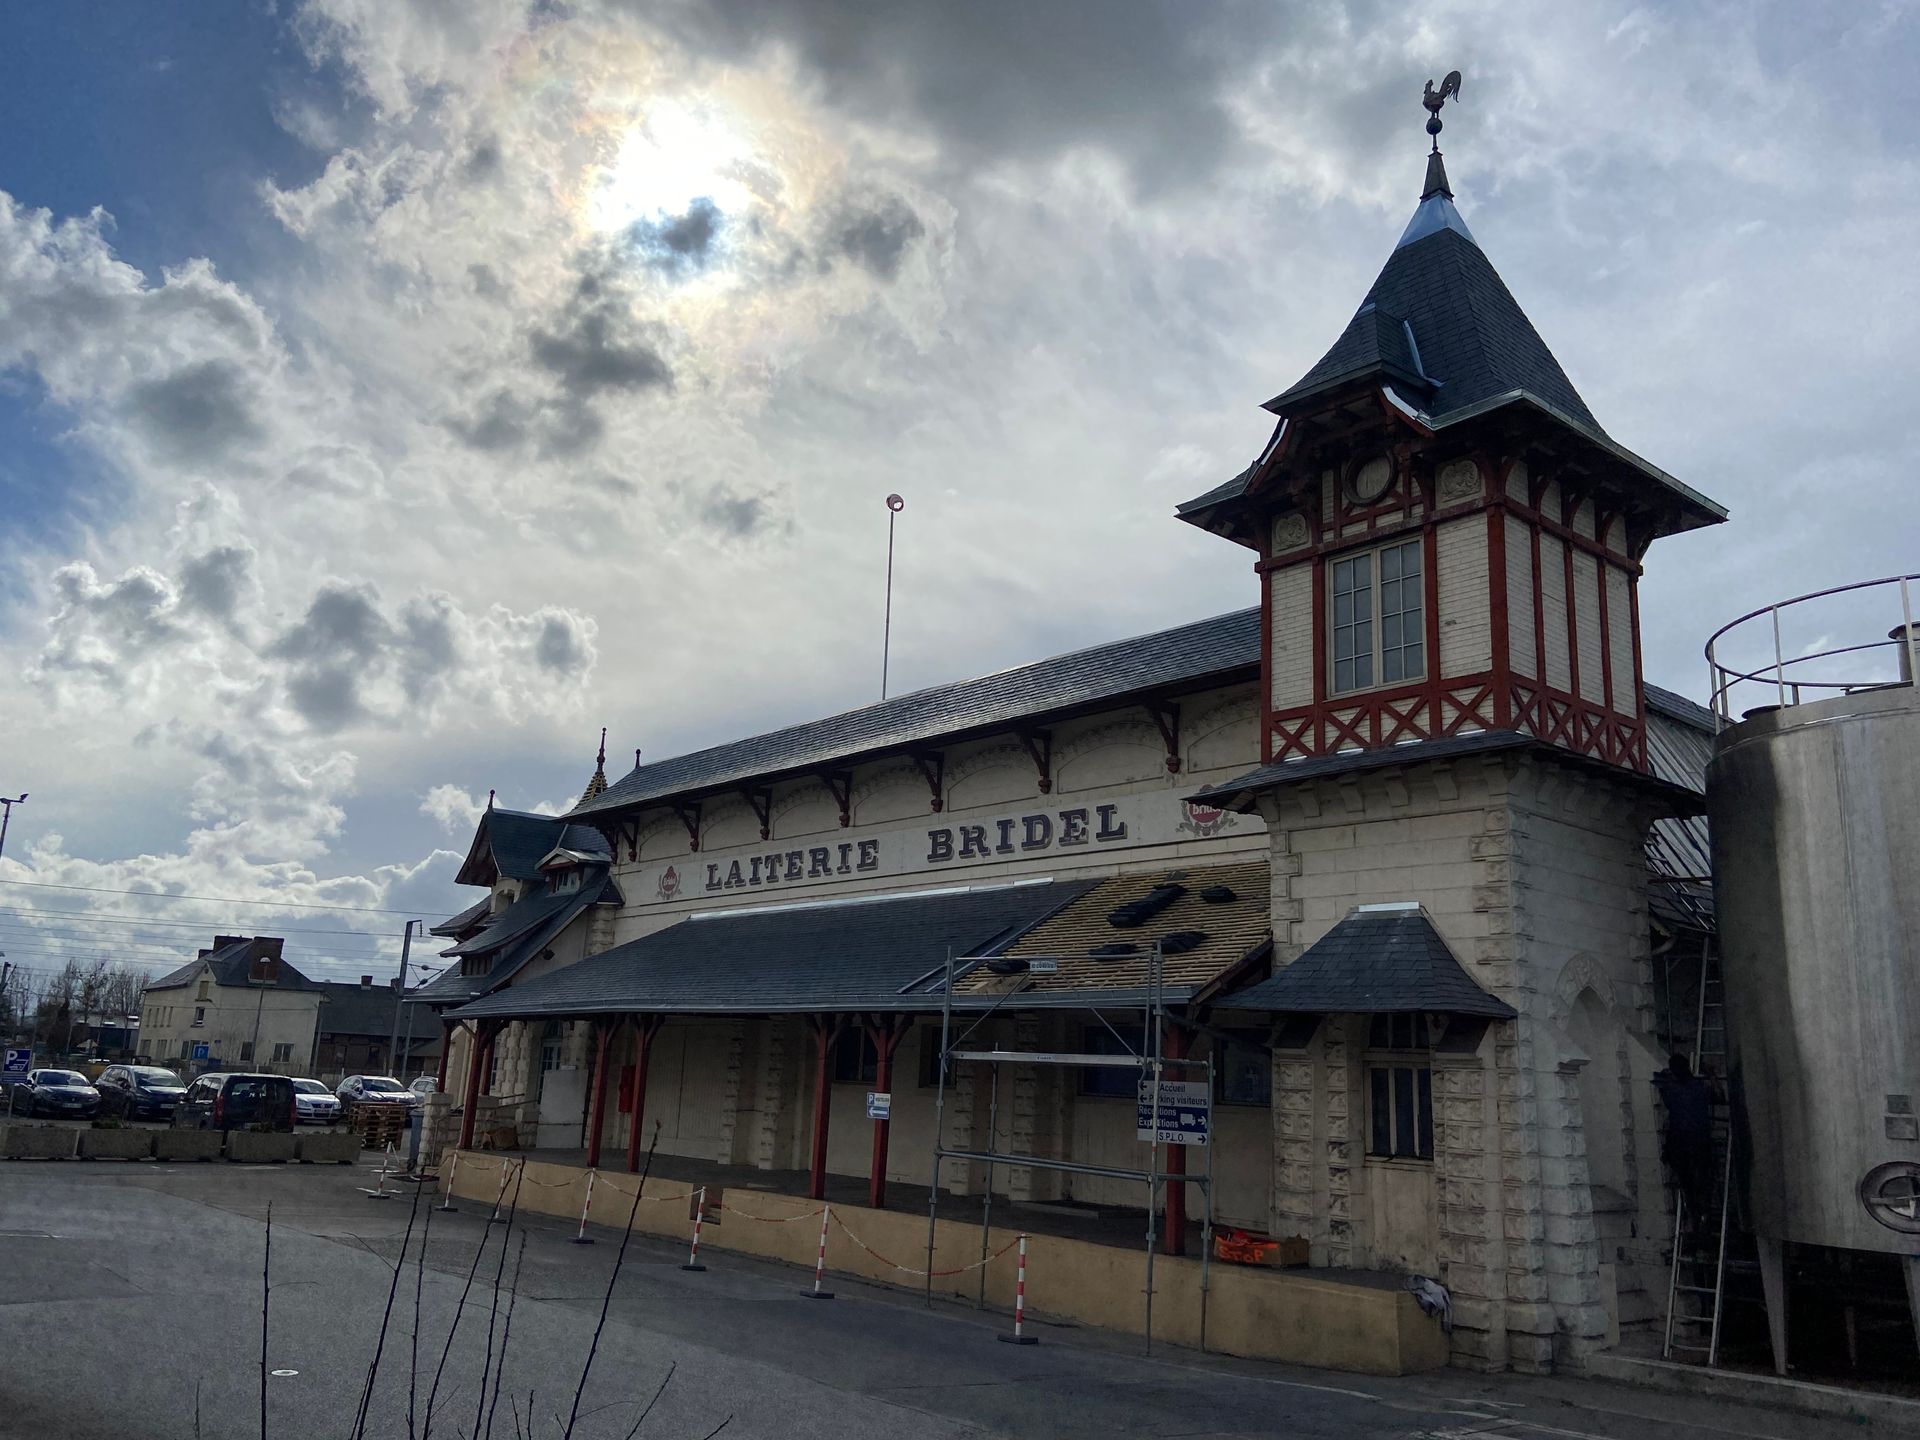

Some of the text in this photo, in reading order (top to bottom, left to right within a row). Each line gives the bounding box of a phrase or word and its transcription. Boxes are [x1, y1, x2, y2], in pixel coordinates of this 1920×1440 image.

[705, 803, 1129, 891] LAITERIE BRIDEL
[5, 1050, 19, 1065] P
[197, 1047, 206, 1057] P
[1160, 1084, 1186, 1093] Accueil
[868, 1094, 874, 1104] P
[1149, 1095, 1207, 1106] Pking visiteurs
[1138, 1117, 1179, 1128] Expitions
